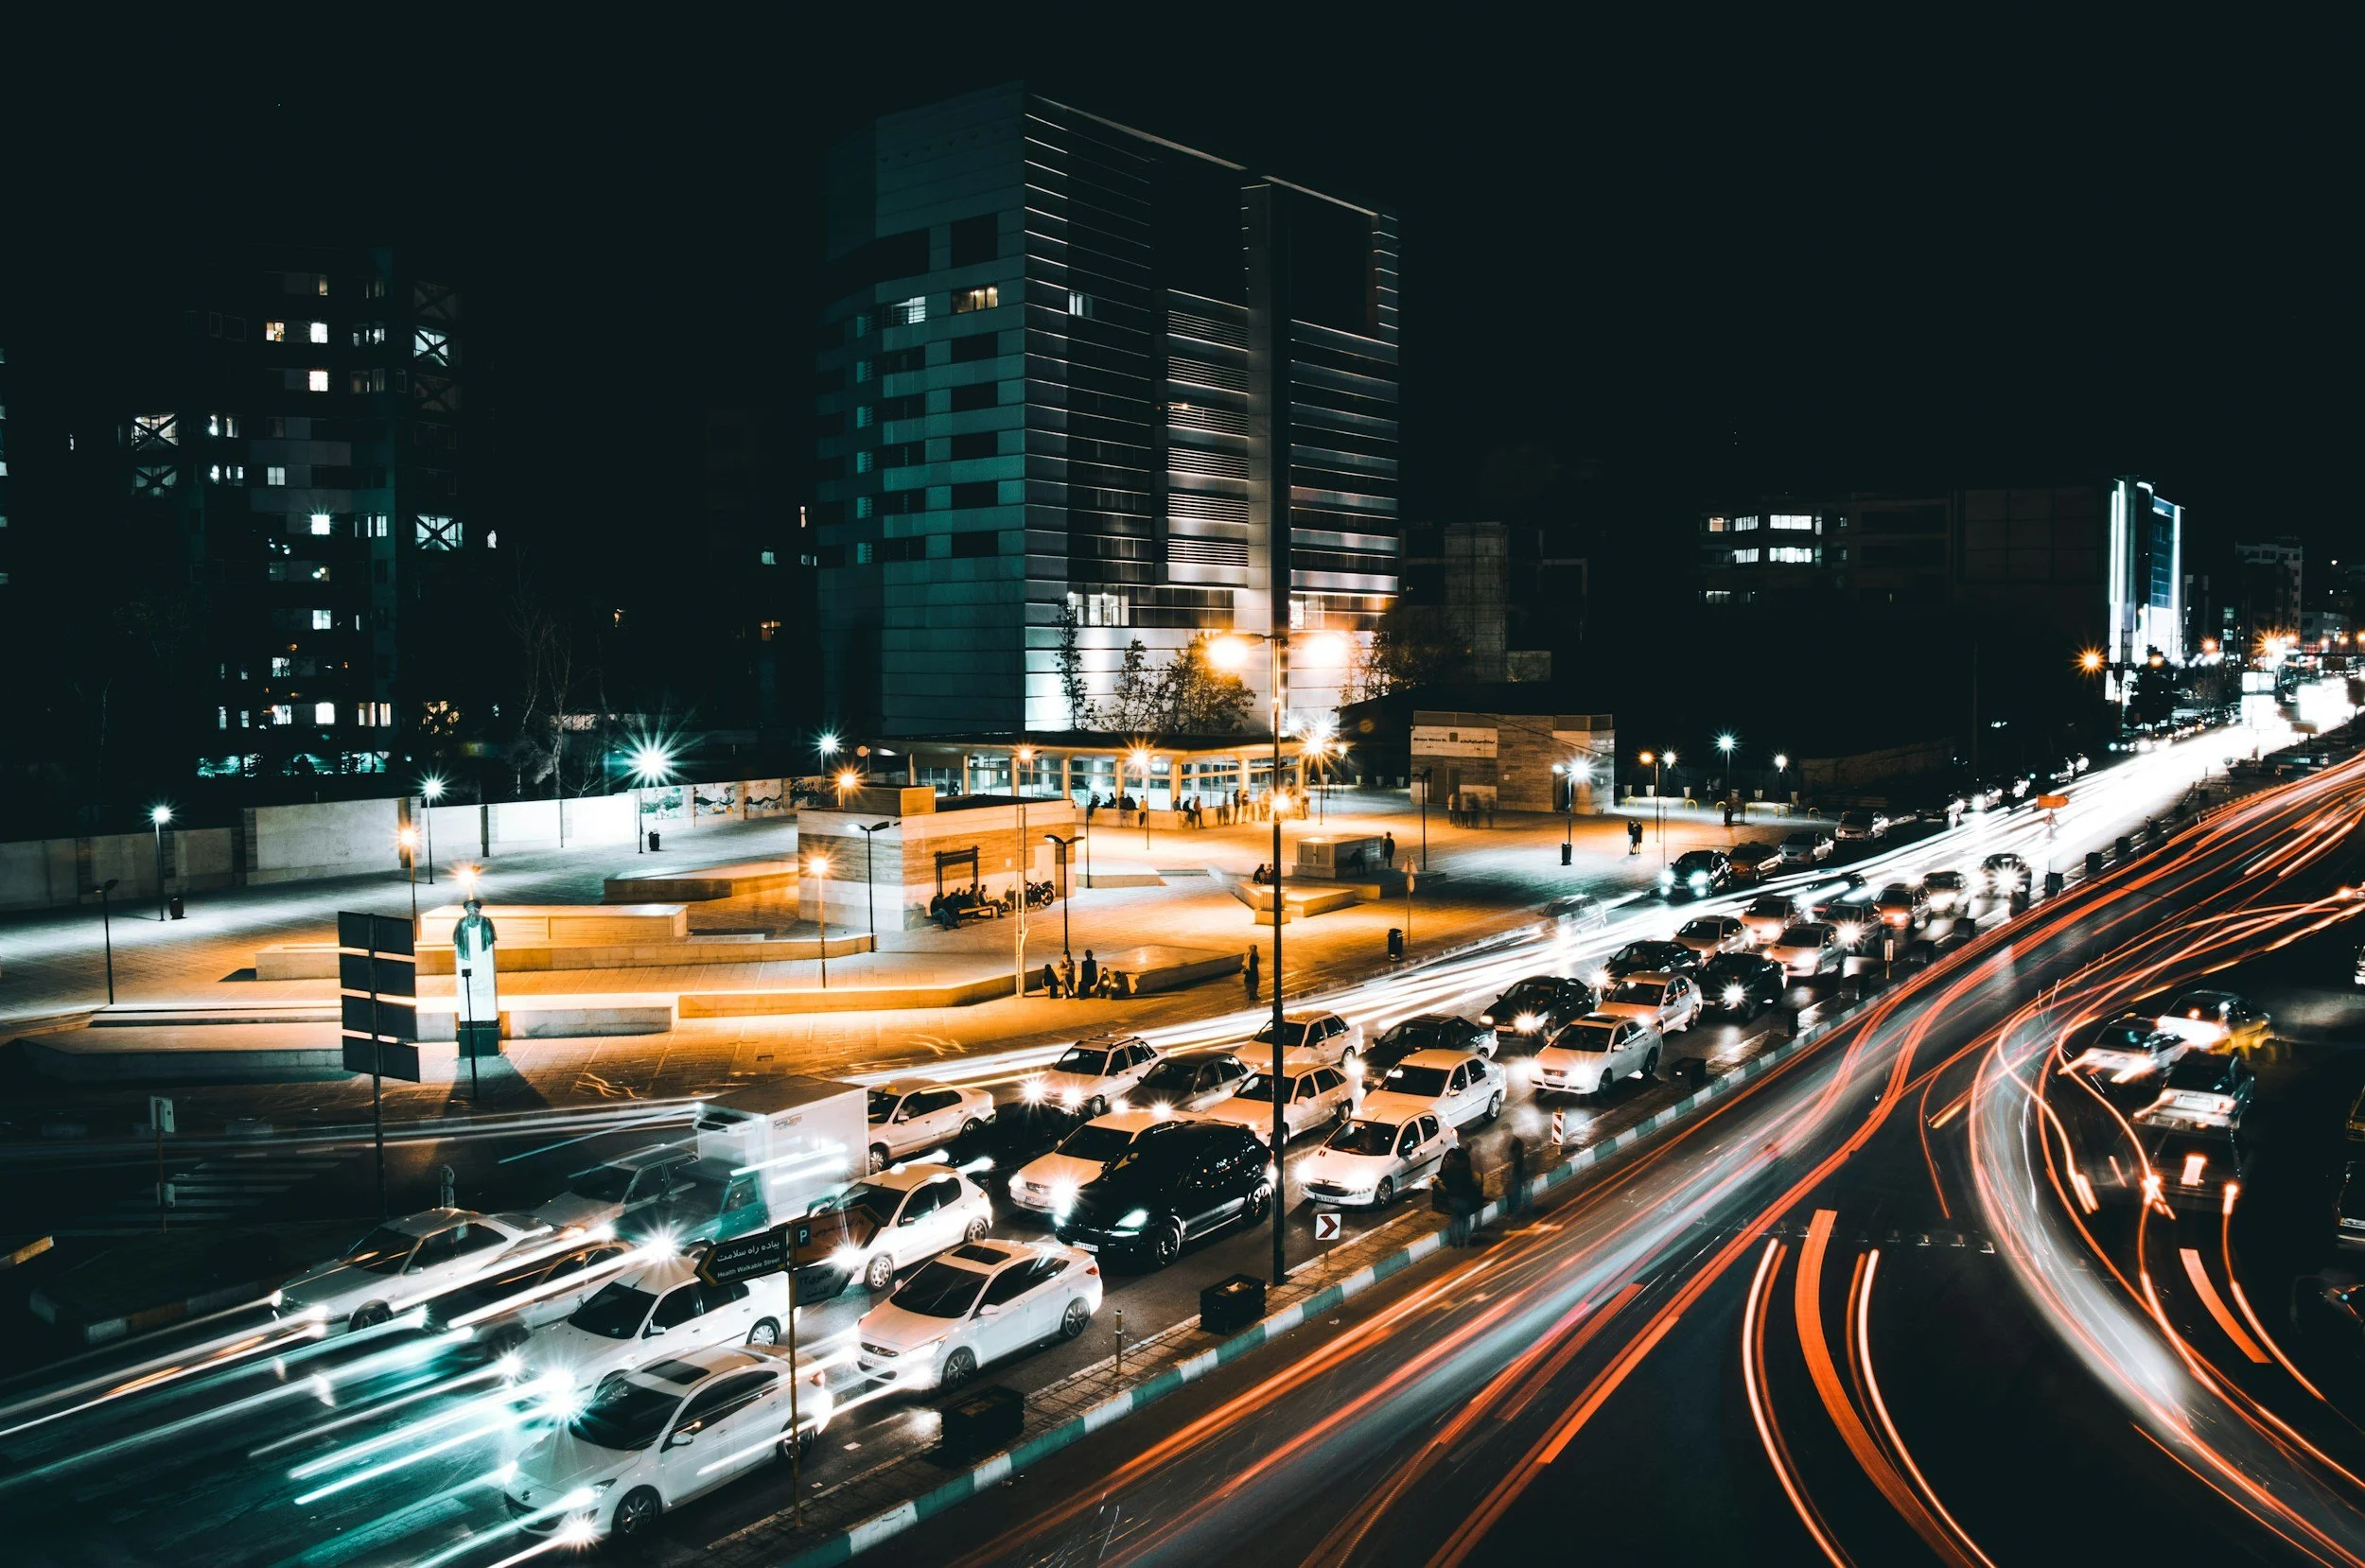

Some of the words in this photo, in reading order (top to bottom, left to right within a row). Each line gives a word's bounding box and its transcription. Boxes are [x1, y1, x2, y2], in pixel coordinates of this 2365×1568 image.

[799, 1229, 808, 1243] P
[747, 1246, 759, 1255] راه
[761, 1240, 780, 1250] پیاده
[717, 1249, 746, 1262] سلامت
[717, 1268, 736, 1278] Health
[737, 1262, 762, 1273] Walkable
[763, 1257, 780, 1266] Street
